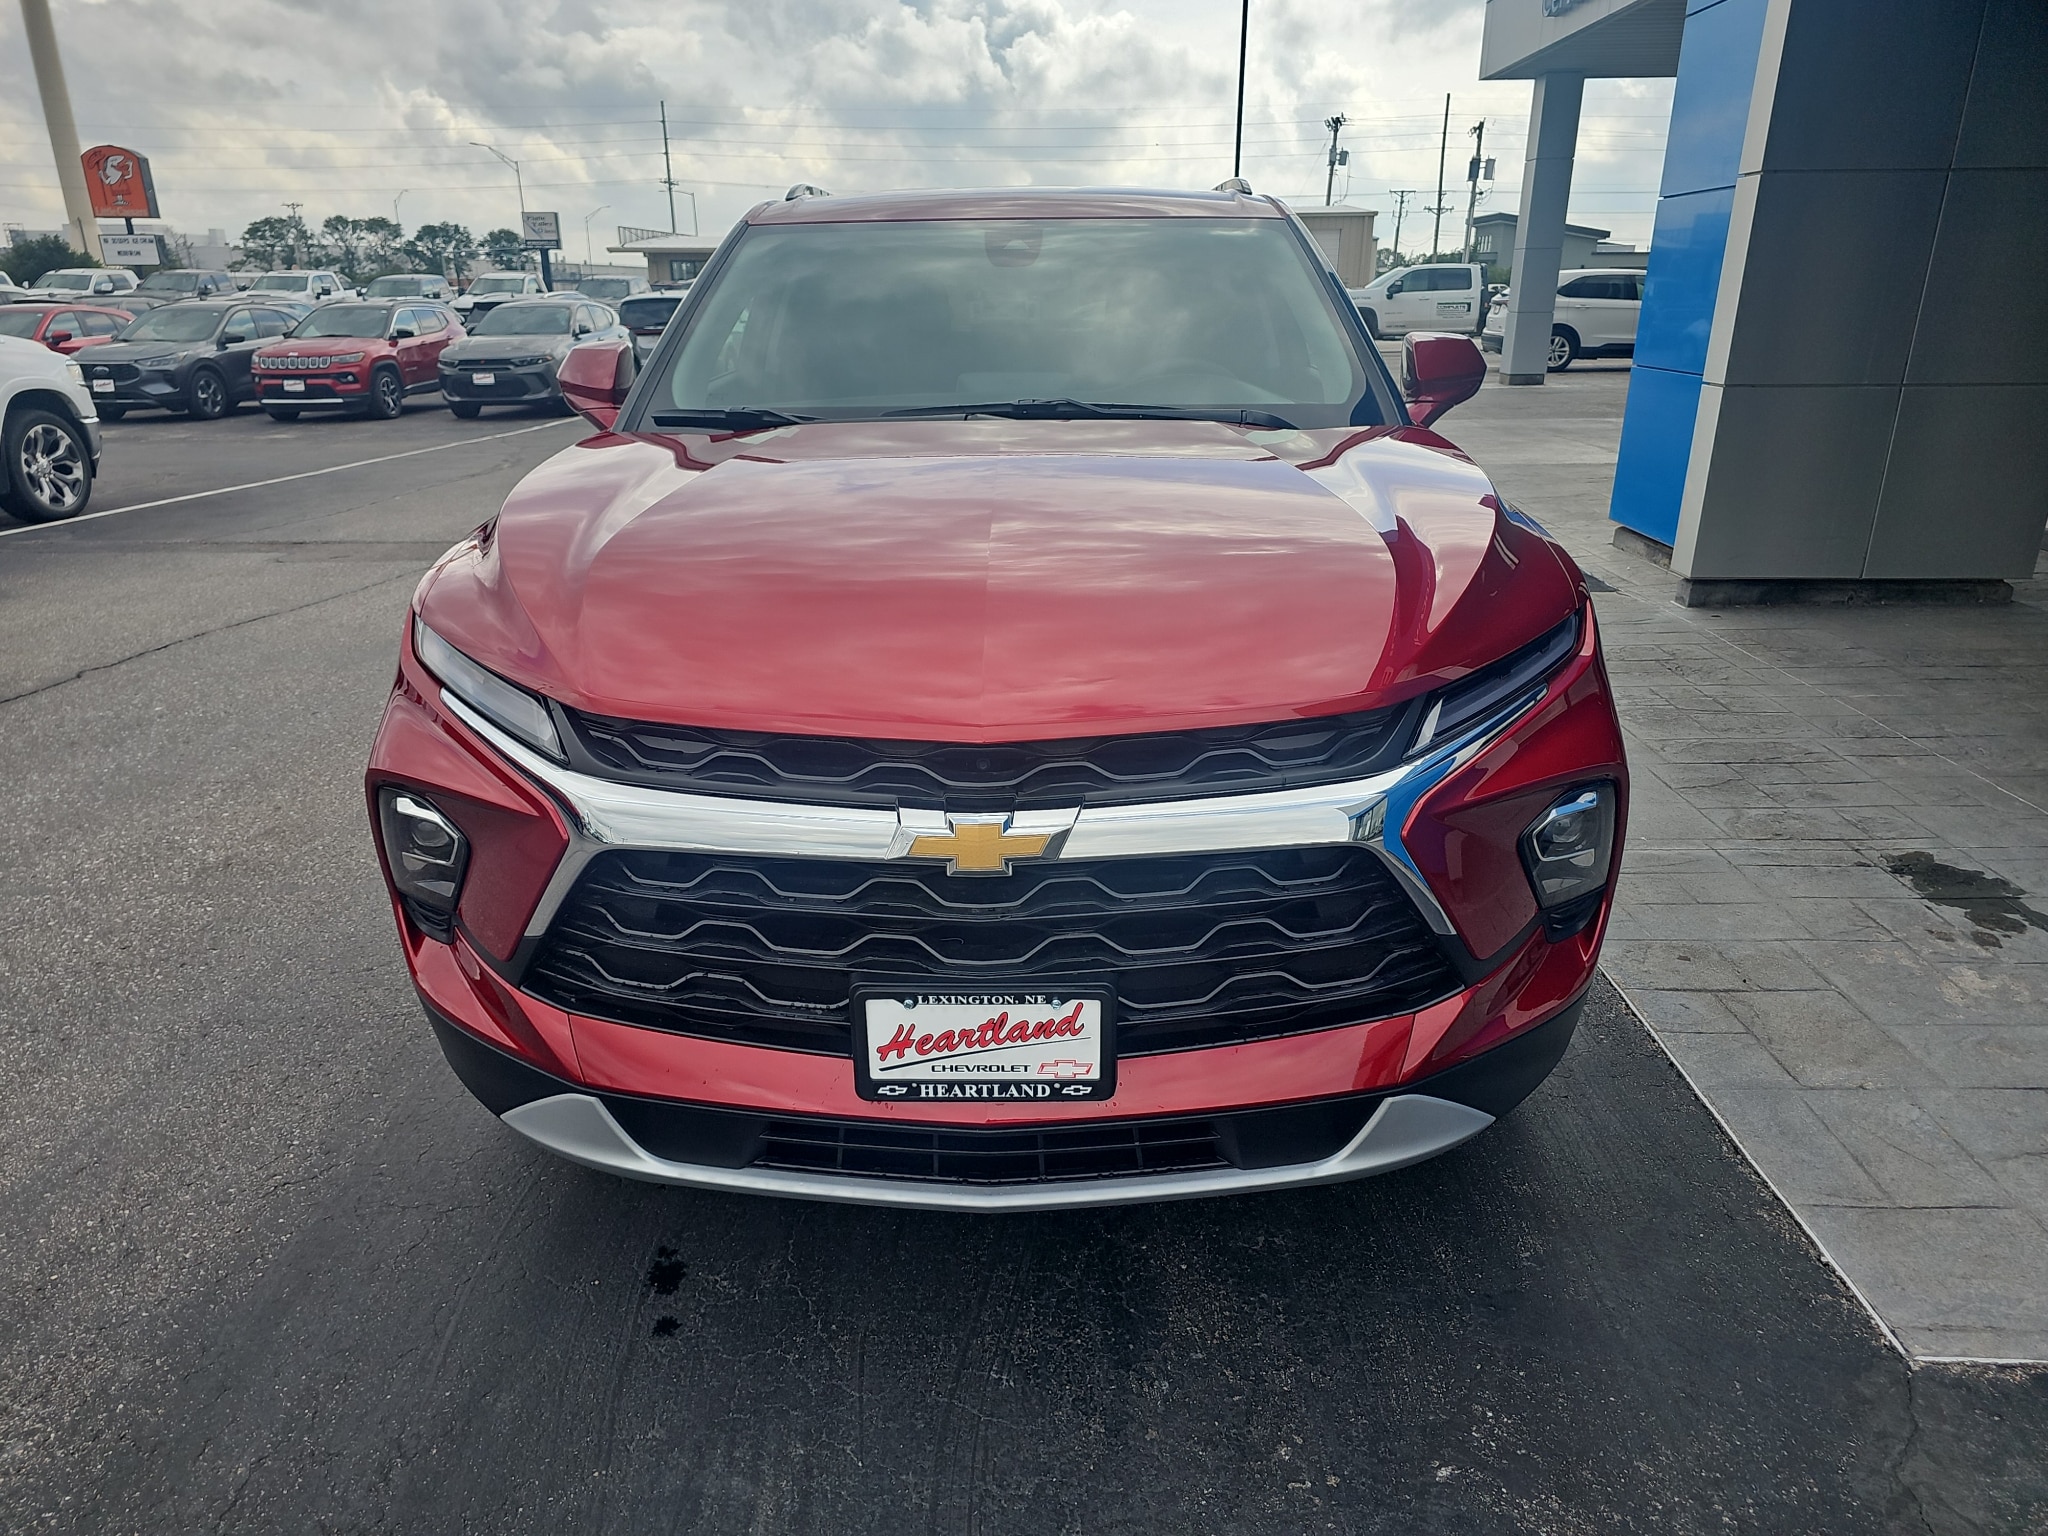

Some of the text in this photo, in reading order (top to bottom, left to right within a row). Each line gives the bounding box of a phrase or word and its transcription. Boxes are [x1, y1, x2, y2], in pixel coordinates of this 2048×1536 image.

[918, 995, 1047, 1005] LEXINGTON, NE
[877, 1001, 1085, 1061] Heartland
[931, 1063, 1031, 1073] CHEVROLET
[919, 1083, 1051, 1098] HEARTLAND
